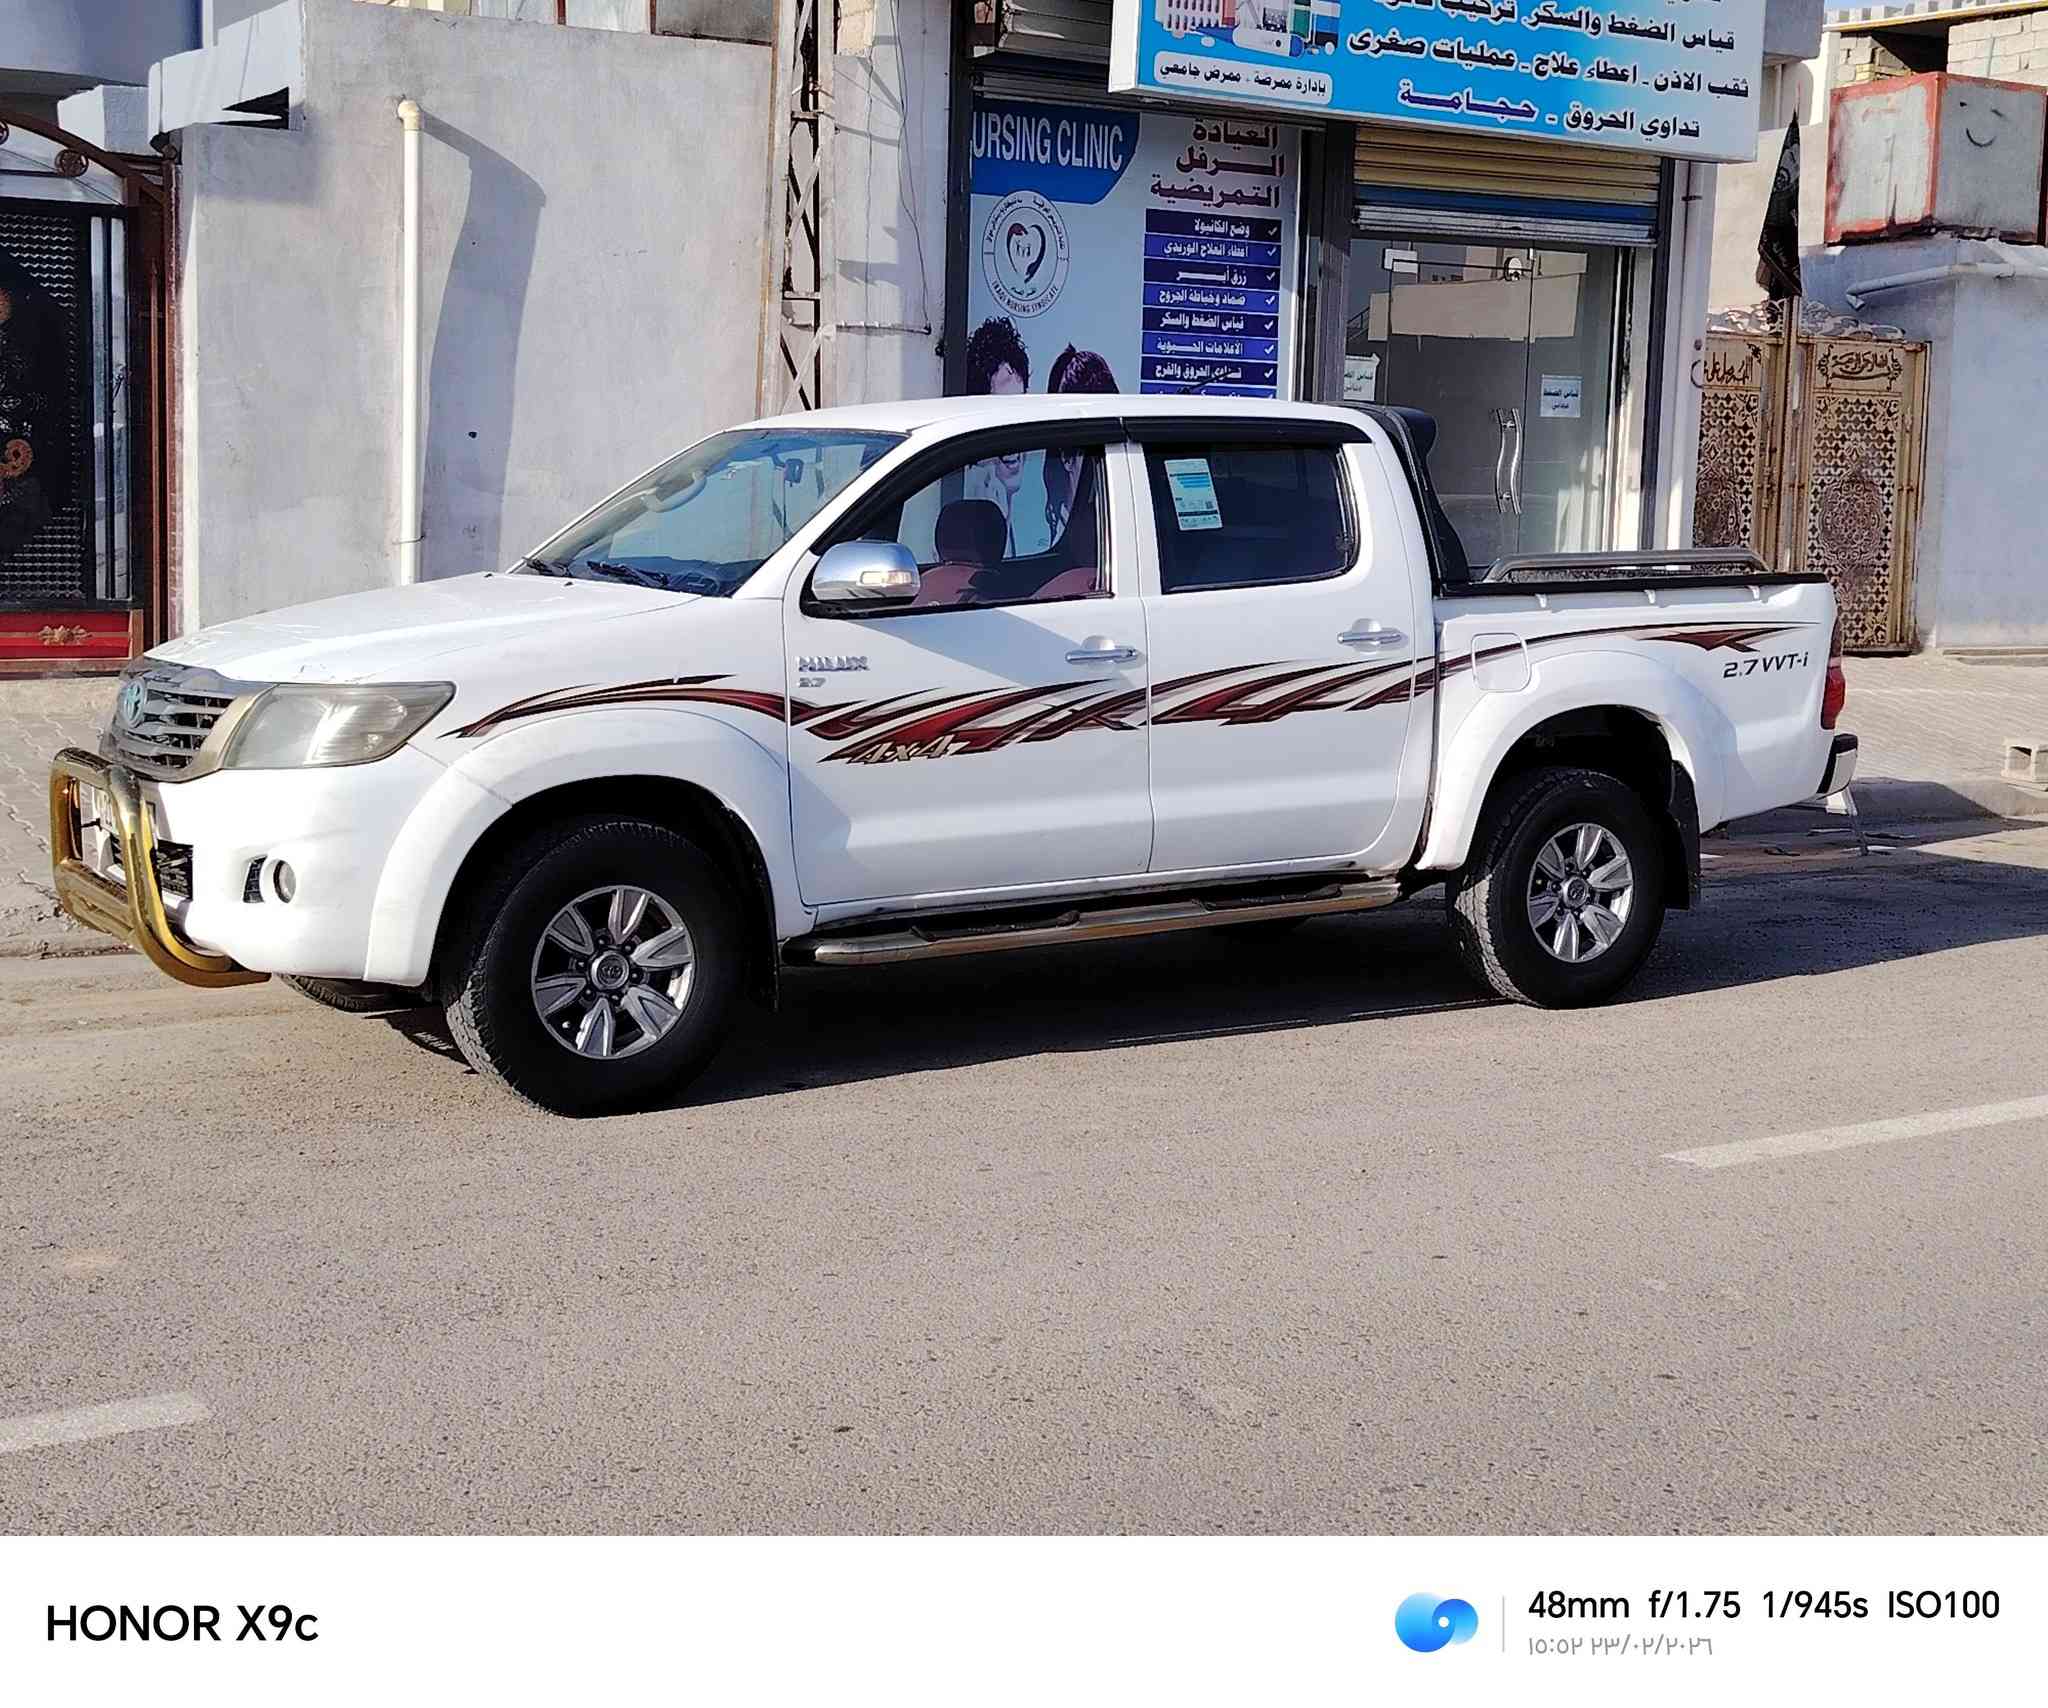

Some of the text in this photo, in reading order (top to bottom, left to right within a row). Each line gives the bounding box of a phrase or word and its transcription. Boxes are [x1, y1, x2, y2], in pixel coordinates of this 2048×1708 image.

[1608, 14, 1675, 42] الضغط
[1683, 29, 1734, 53] قياس
[1160, 61, 1200, 79] جامعي
[1349, 30, 1749, 99] ثقب الاذن اعطاء علاج عمليات صغرى
[1400, 82, 1700, 141] تداوي الحروق حجامة
[973, 111, 1123, 171] URSING CLINIC
[1193, 117, 1278, 150] العيادة
[1151, 174, 1279, 208] التمريضية
[1229, 222, 1250, 238] وضع
[1164, 242, 1198, 257] الوريدي
[1200, 243, 1225, 257] العلاج
[1230, 269, 1247, 286] زرق
[1159, 288, 1187, 304] الجروح
[1222, 292, 1246, 305] ضماد
[1160, 312, 1244, 331] قياس الضغط والسكر
[1182, 364, 1210, 379] الحروق
[1723, 652, 1809, 678] 2.7 VVT-i
